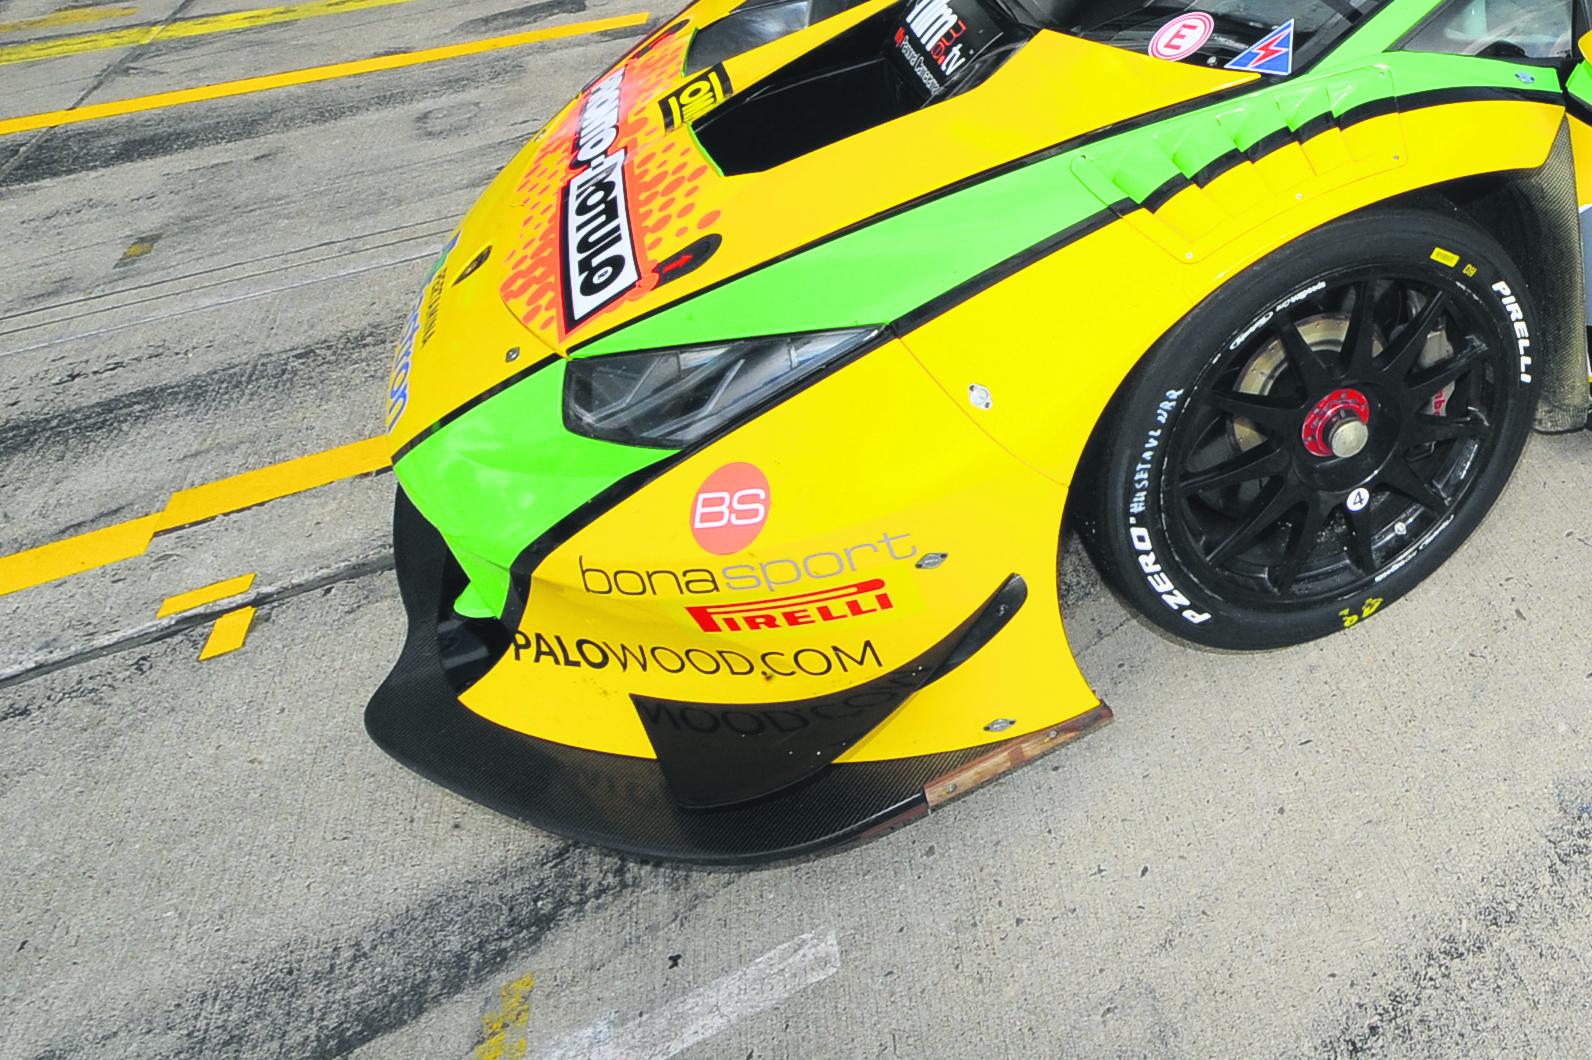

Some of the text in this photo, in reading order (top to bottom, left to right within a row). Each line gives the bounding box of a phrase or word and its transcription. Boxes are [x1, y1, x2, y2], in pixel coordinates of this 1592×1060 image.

[1163, 23, 1198, 51] E
[1491, 280, 1532, 384] PIRELLI
[693, 487, 767, 530] BS
[685, 578, 895, 633] PIRELLI
[512, 629, 884, 678] PALOWOOD.COM
